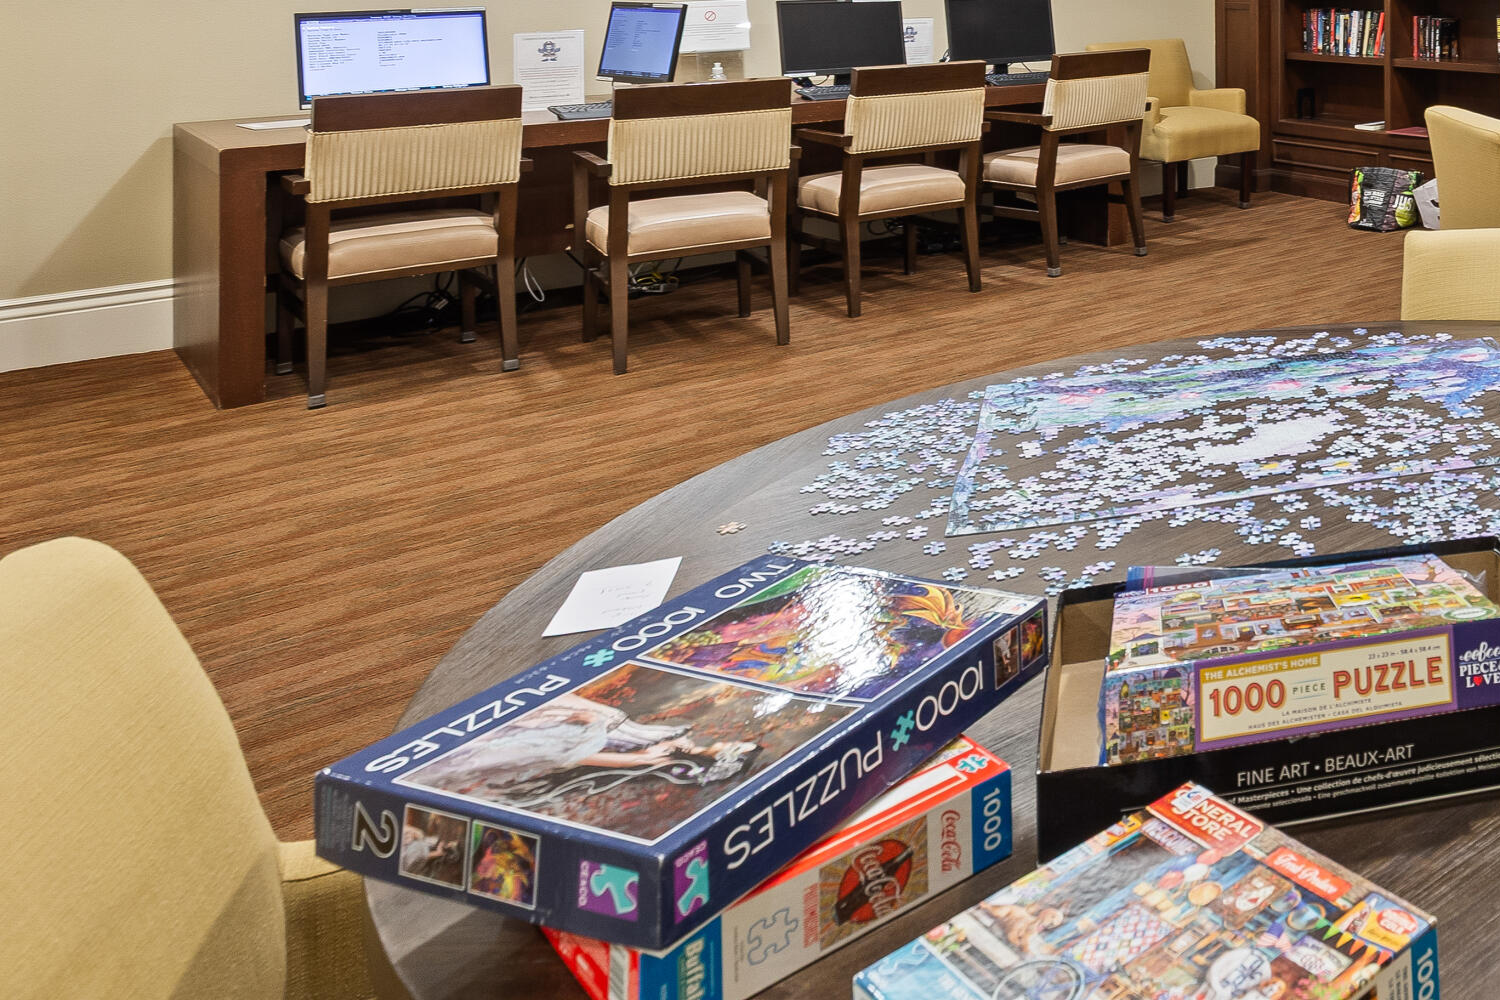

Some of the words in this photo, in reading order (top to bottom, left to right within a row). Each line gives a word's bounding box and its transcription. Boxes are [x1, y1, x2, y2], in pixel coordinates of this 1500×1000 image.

[714, 557, 800, 601] TWO
[612, 605, 704, 653] 1000
[1204, 670, 1225, 680] THE
[1227, 660, 1288, 677] ALCHEMIST'S
[1290, 657, 1319, 668] HOME
[1209, 679, 1286, 717] 1000
[1292, 682, 1327, 695] PIECE
[1333, 656, 1444, 700] PUZZLE
[915, 659, 987, 733] 1000
[1291, 706, 1317, 715] MAISON
[364, 672, 572, 775] PUZZLES
[1237, 767, 1275, 787] FINE
[1279, 761, 1311, 782] ART
[1325, 744, 1415, 774] BEAUX-ART
[1238, 789, 1289, 805] Masterpieces
[1313, 777, 1351, 791] collection
[1352, 775, 1362, 784] de
[722, 730, 884, 871] PUZZLES
[982, 787, 1002, 851] 1000
[1174, 788, 1250, 838] GNERAL
[352, 800, 399, 859] 2
